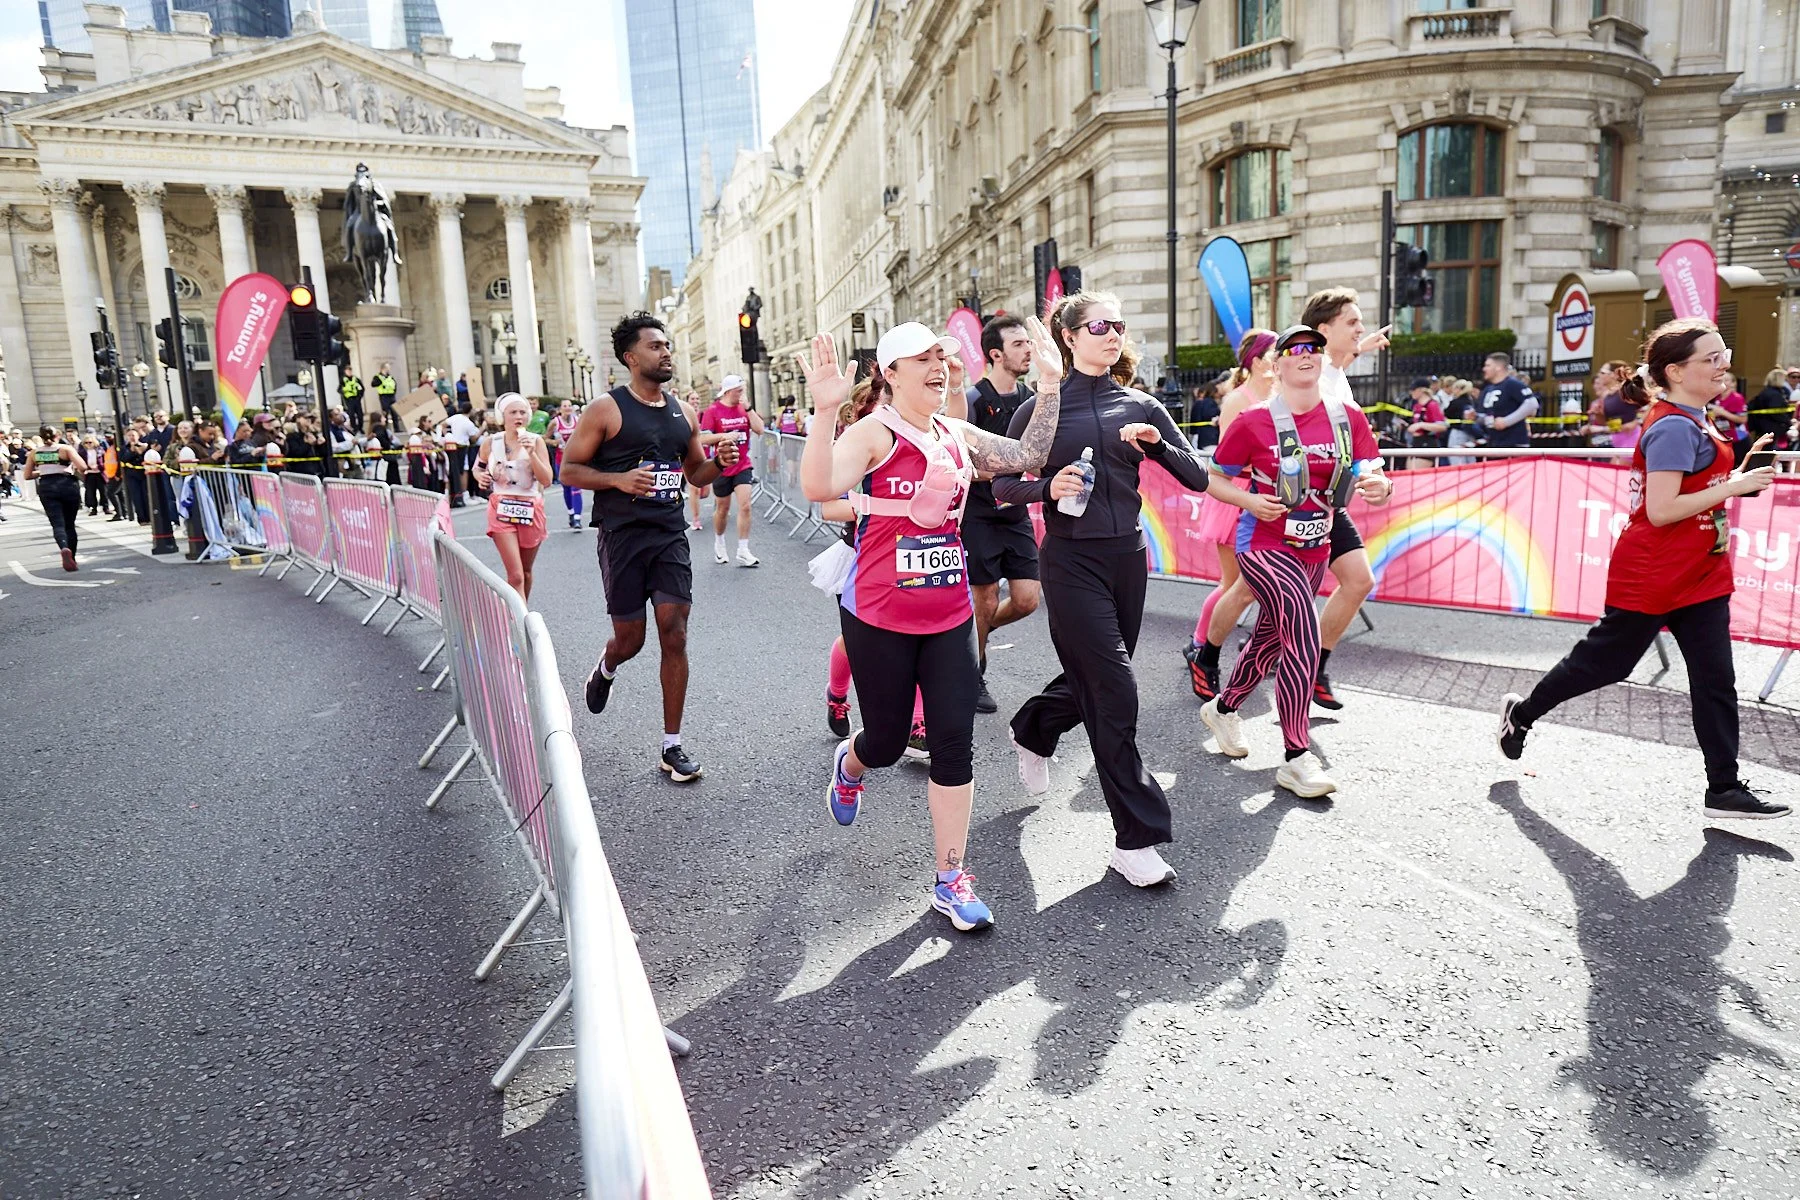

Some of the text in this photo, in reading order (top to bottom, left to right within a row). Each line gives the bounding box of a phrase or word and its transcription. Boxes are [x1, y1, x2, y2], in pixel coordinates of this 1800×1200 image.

[226, 291, 268, 363] Tommy's
[1558, 312, 1592, 328] UNDERGROUND
[503, 505, 528, 516] 9456
[1295, 520, 1329, 536] 9288
[920, 536, 947, 544] HANNAH
[903, 549, 959, 569] 11666
[1575, 552, 1601, 566] The
[1733, 574, 1768, 592] aby
